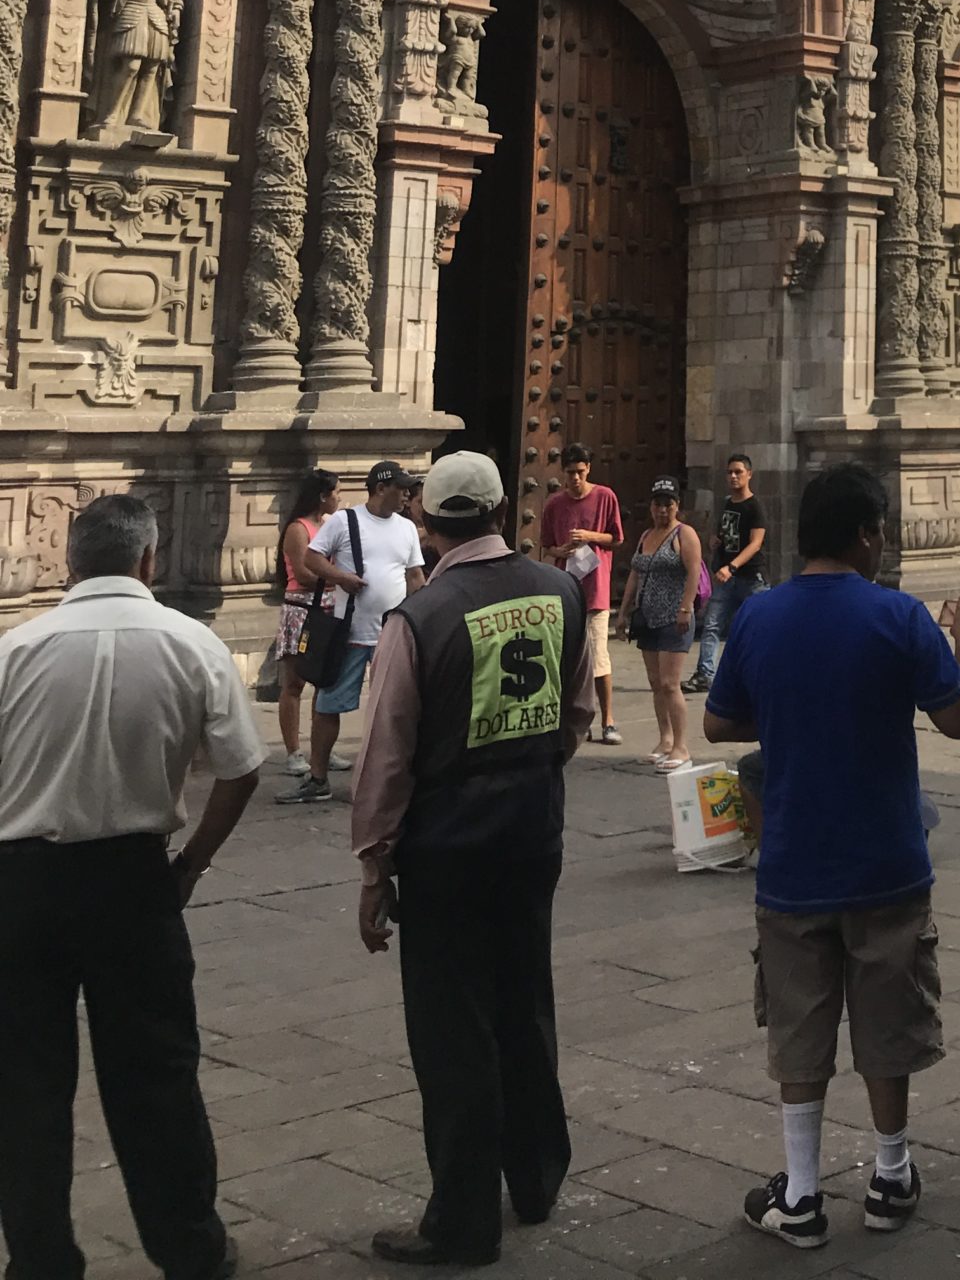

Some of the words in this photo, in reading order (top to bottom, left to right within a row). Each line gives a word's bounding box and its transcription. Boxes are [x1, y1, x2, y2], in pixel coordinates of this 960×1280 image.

[476, 603, 557, 639] EUROS
[500, 631, 547, 703] $
[475, 702, 558, 739] DOLARES
